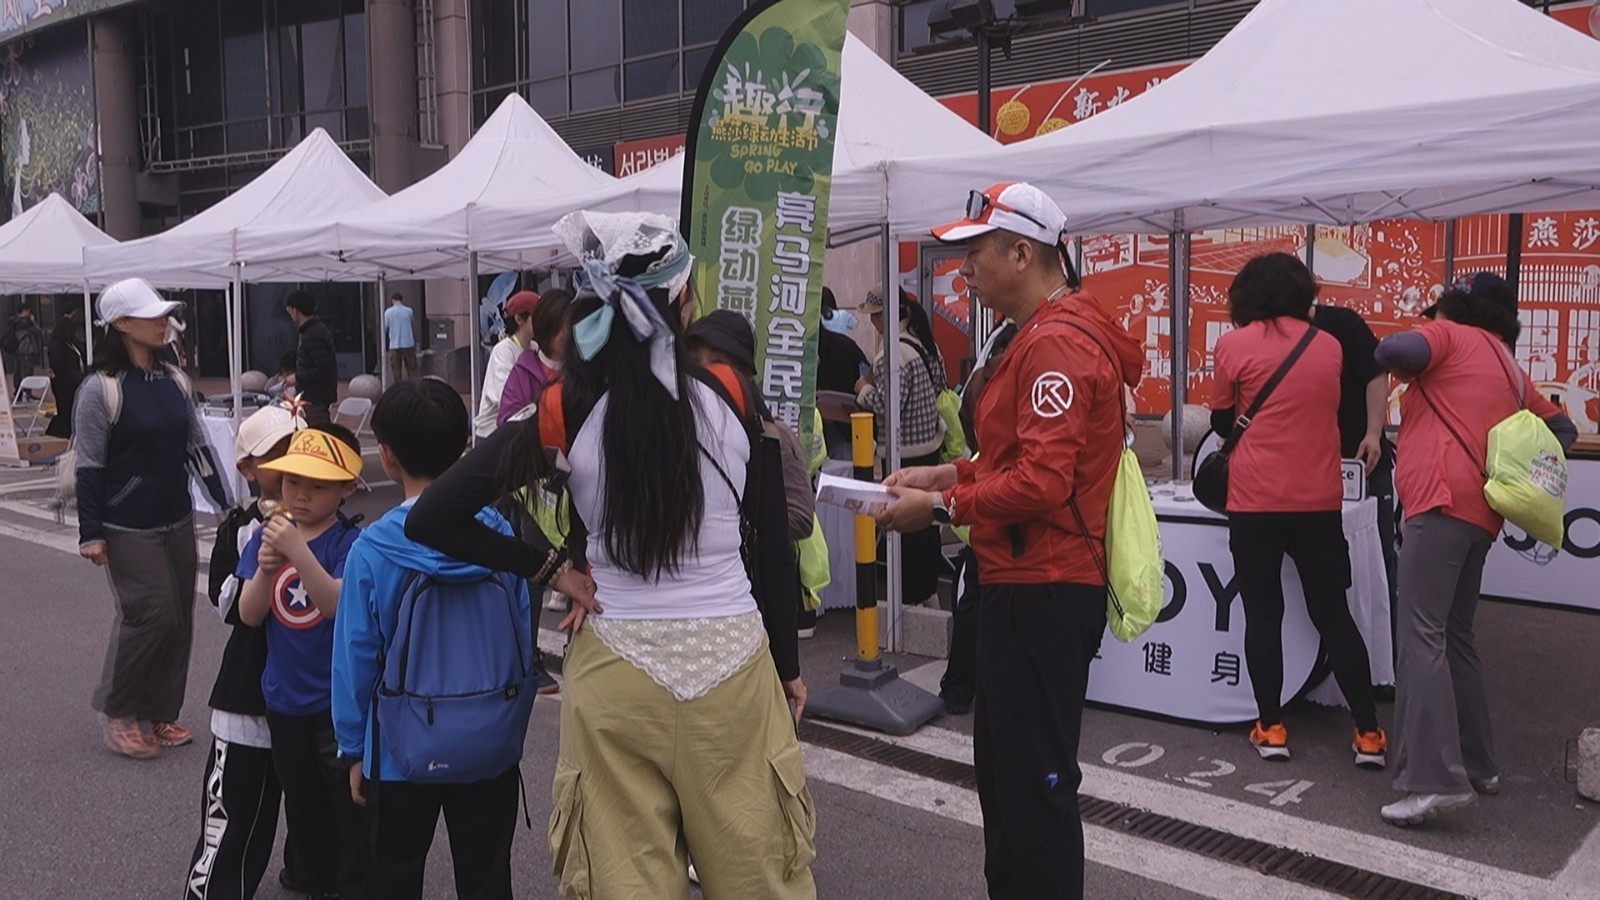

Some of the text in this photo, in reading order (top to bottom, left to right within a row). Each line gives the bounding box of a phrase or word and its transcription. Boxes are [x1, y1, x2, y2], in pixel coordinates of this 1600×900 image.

[730, 144, 782, 159] SPRING
[744, 159, 798, 175] GO PLAY
[1527, 216, 1600, 251] 燕莎
[1101, 742, 1316, 807] 024
